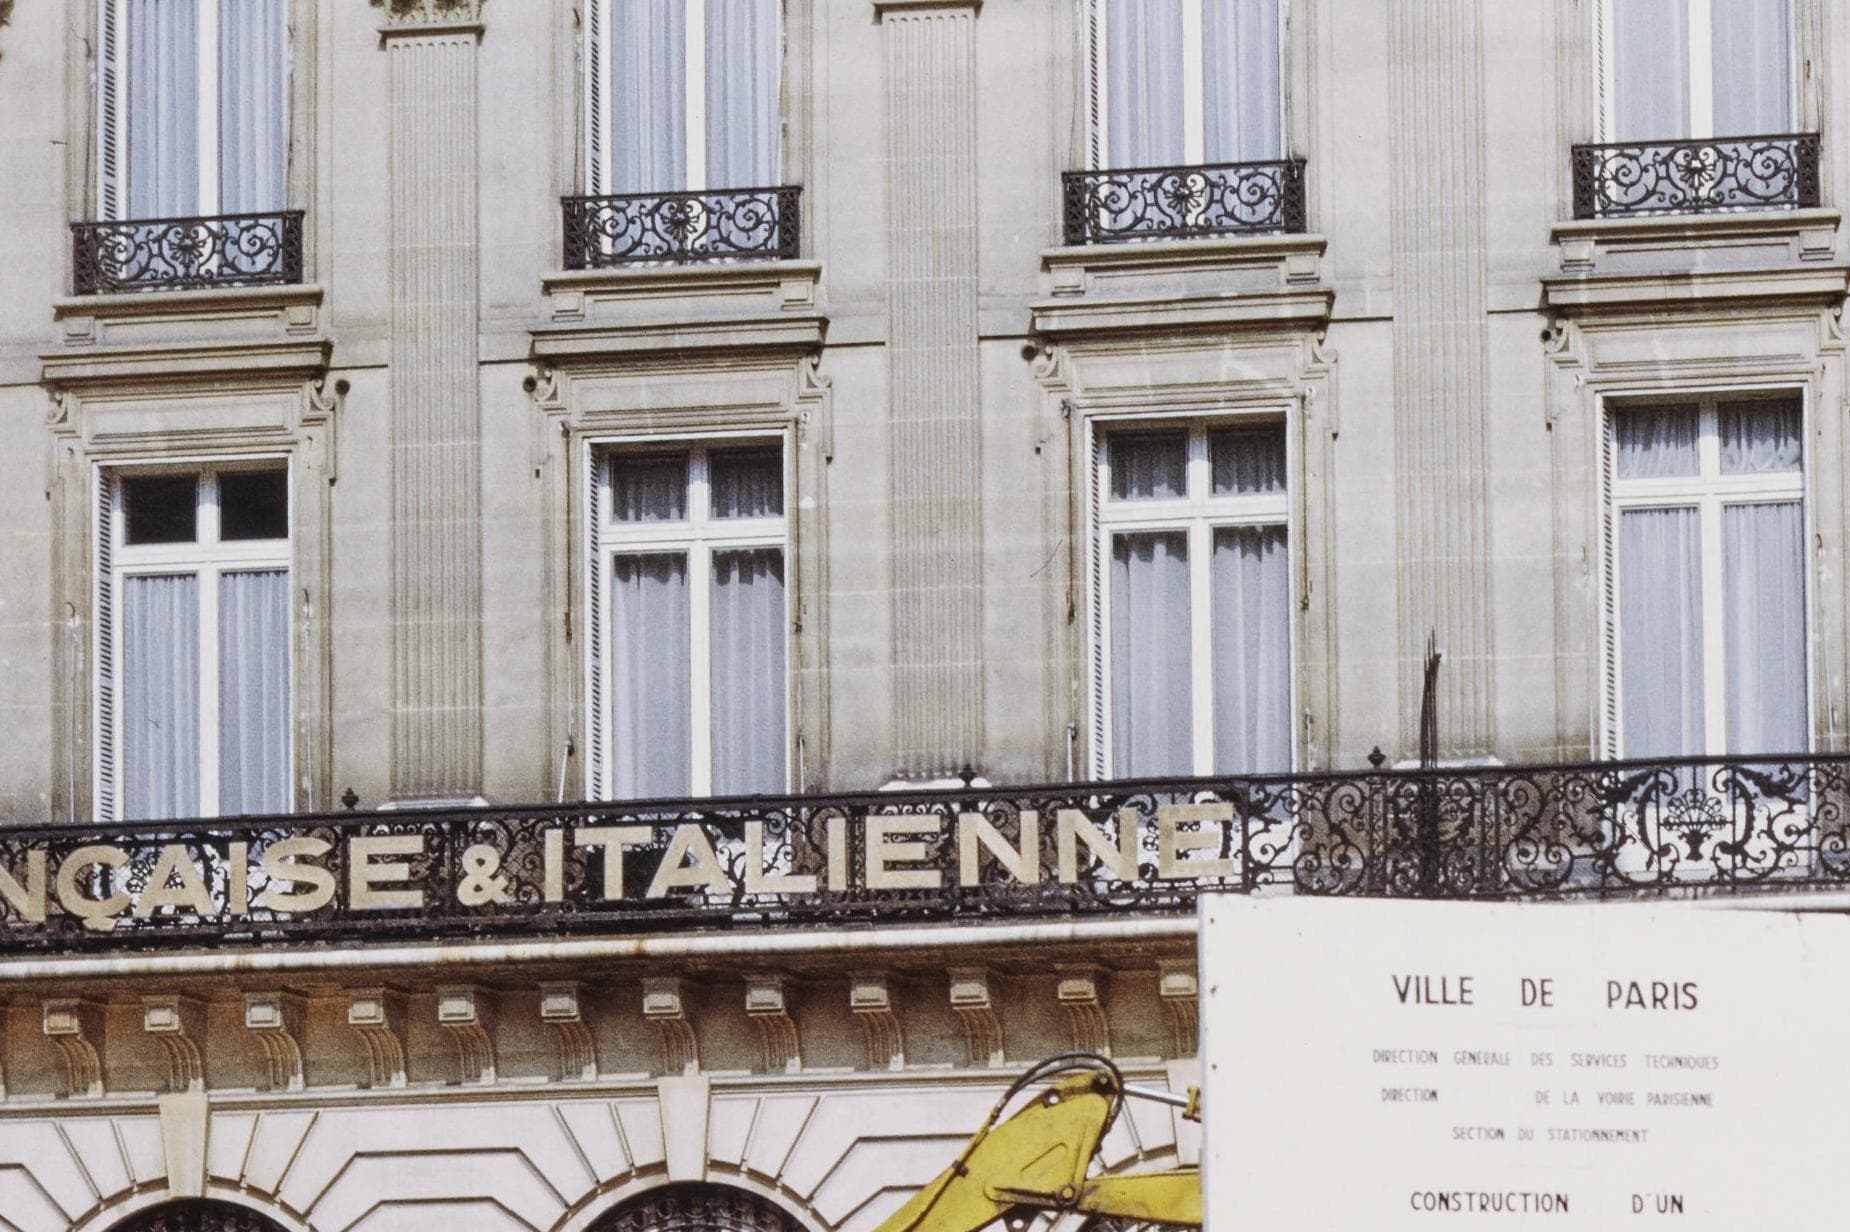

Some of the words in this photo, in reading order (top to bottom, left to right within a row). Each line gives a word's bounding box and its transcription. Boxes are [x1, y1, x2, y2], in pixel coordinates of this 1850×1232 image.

[457, 842, 516, 908] &
[543, 801, 1236, 905] ITALIENNE
[1392, 974, 1474, 1006] VILLE
[1521, 977, 1554, 1008] DE
[1607, 980, 1699, 1011] PARIS
[1373, 1049, 1439, 1065] DIRECTION
[1531, 1052, 1554, 1068] DES
[1570, 1052, 1628, 1069] SERVICES
[1645, 1053, 1720, 1071] TECHNIQUES
[1381, 1087, 1439, 1103] DIRECTION
[1535, 1091, 1550, 1106] DE
[1563, 1091, 1580, 1106] LA
[1596, 1091, 1635, 1106] VOIRIE
[1647, 1092, 1714, 1108] PARISIENNE
[1452, 1126, 1505, 1142] SECTION
[1517, 1127, 1535, 1142] DU
[1548, 1127, 1648, 1144] STATIONNEMENT
[1410, 1191, 1570, 1214] CONSTRUCTION
